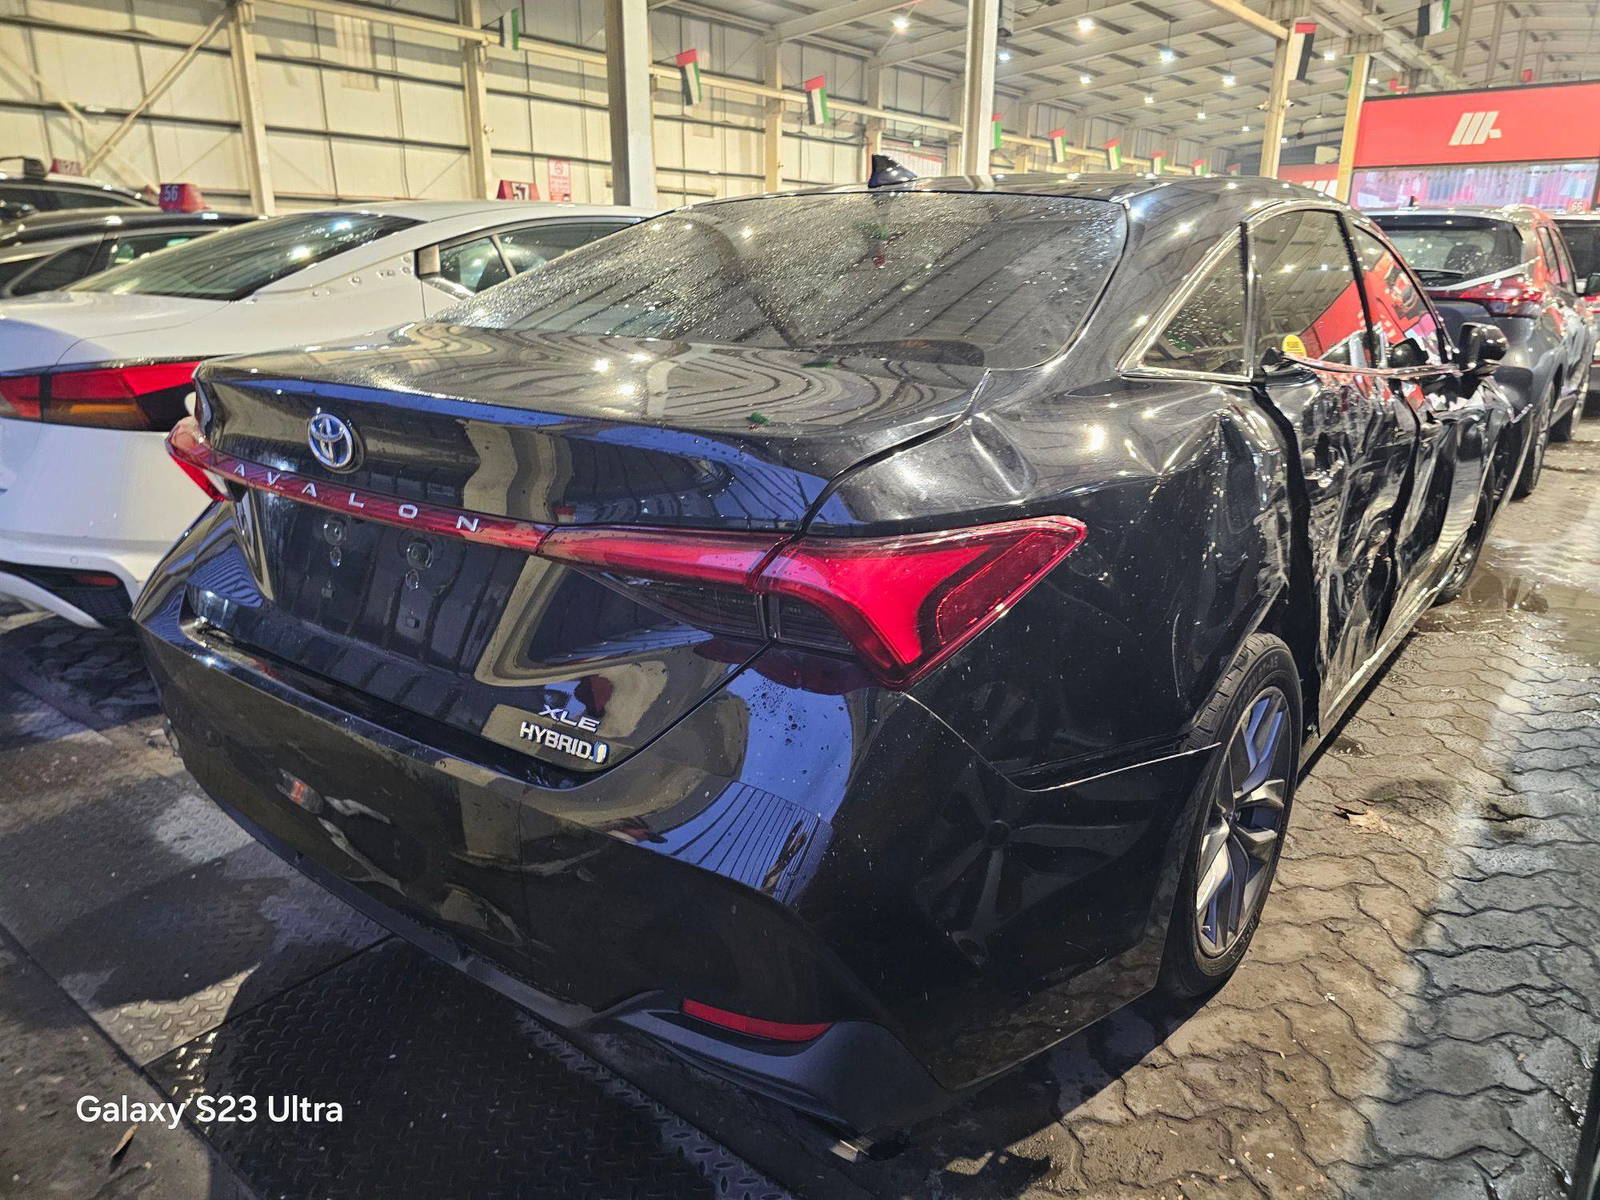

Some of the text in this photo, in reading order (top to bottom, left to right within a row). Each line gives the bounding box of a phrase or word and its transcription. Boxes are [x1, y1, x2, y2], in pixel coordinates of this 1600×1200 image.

[164, 186, 178, 201] 56
[512, 183, 529, 200] 57
[233, 463, 479, 532] AVALON
[538, 703, 600, 733] XLE
[519, 721, 593, 760] HYBRID
